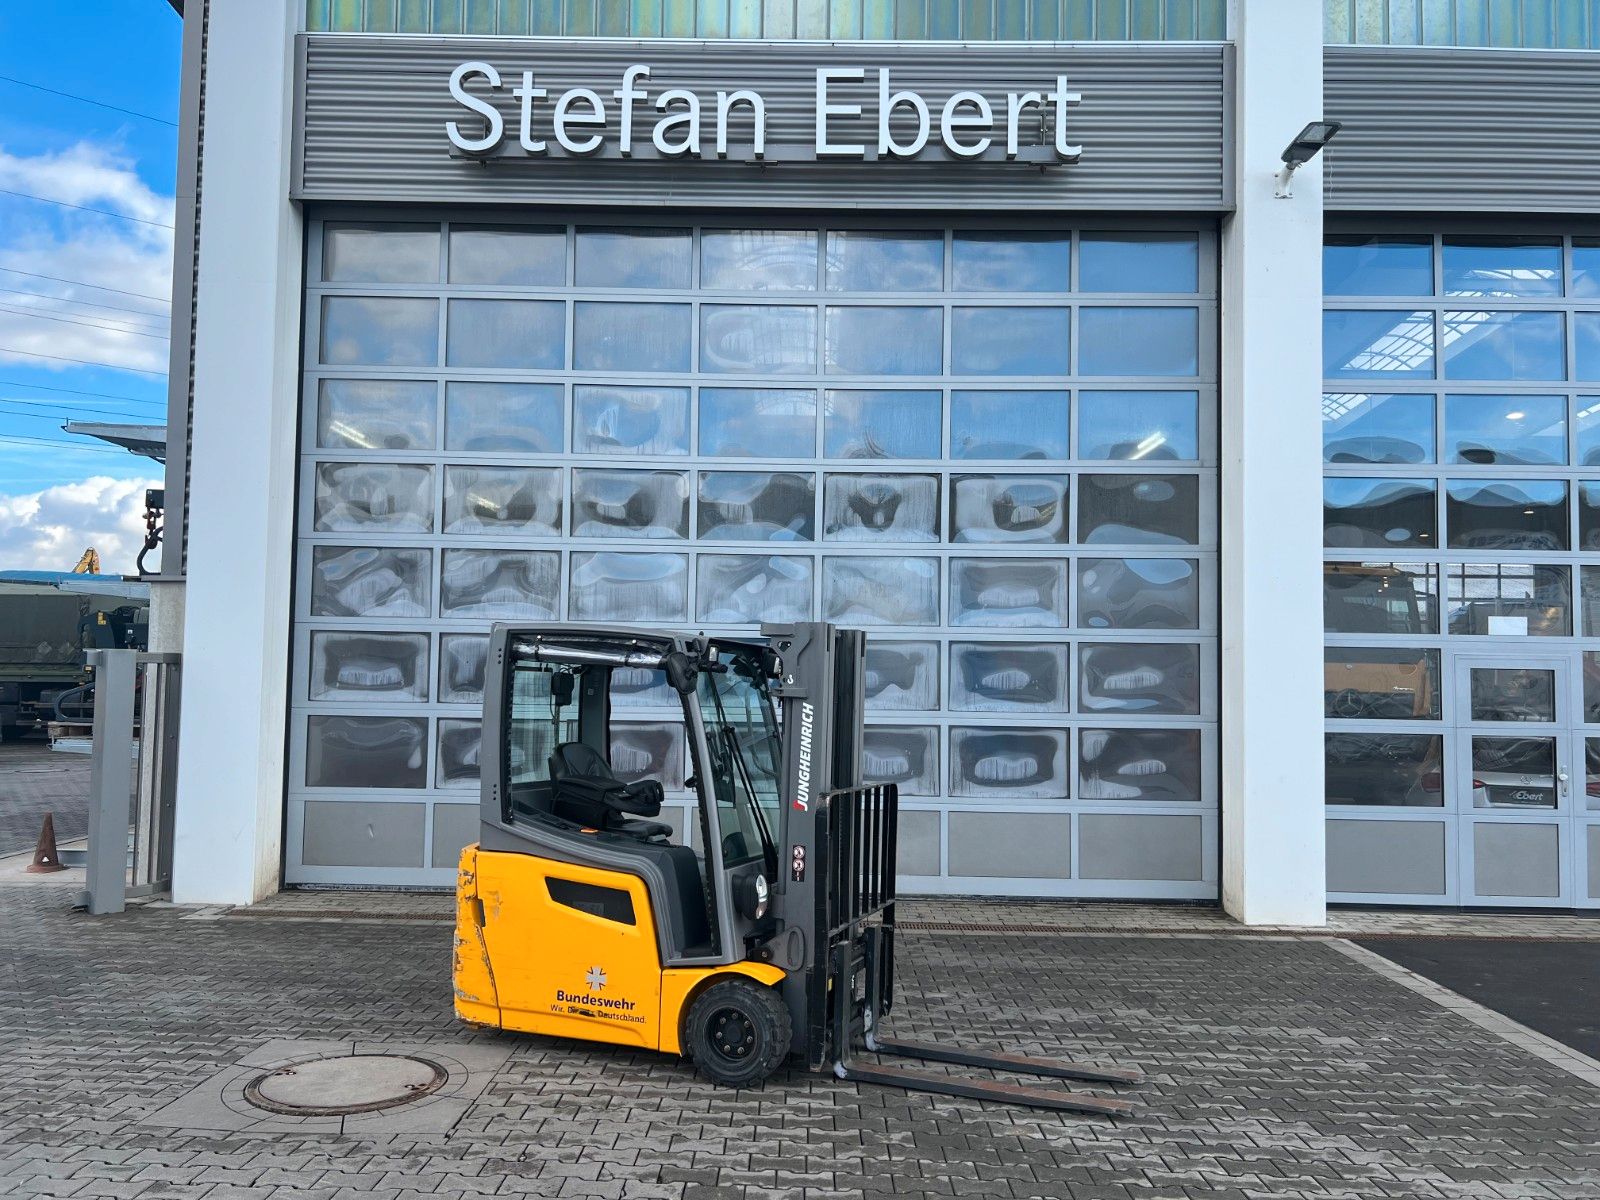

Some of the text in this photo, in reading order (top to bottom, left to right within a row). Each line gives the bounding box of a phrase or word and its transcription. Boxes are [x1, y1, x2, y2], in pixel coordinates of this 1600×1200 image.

[445, 61, 1082, 158] Stefan Ebert
[793, 702, 814, 812] JUNGHEINRICH
[556, 990, 636, 1011] Bundeswehr
